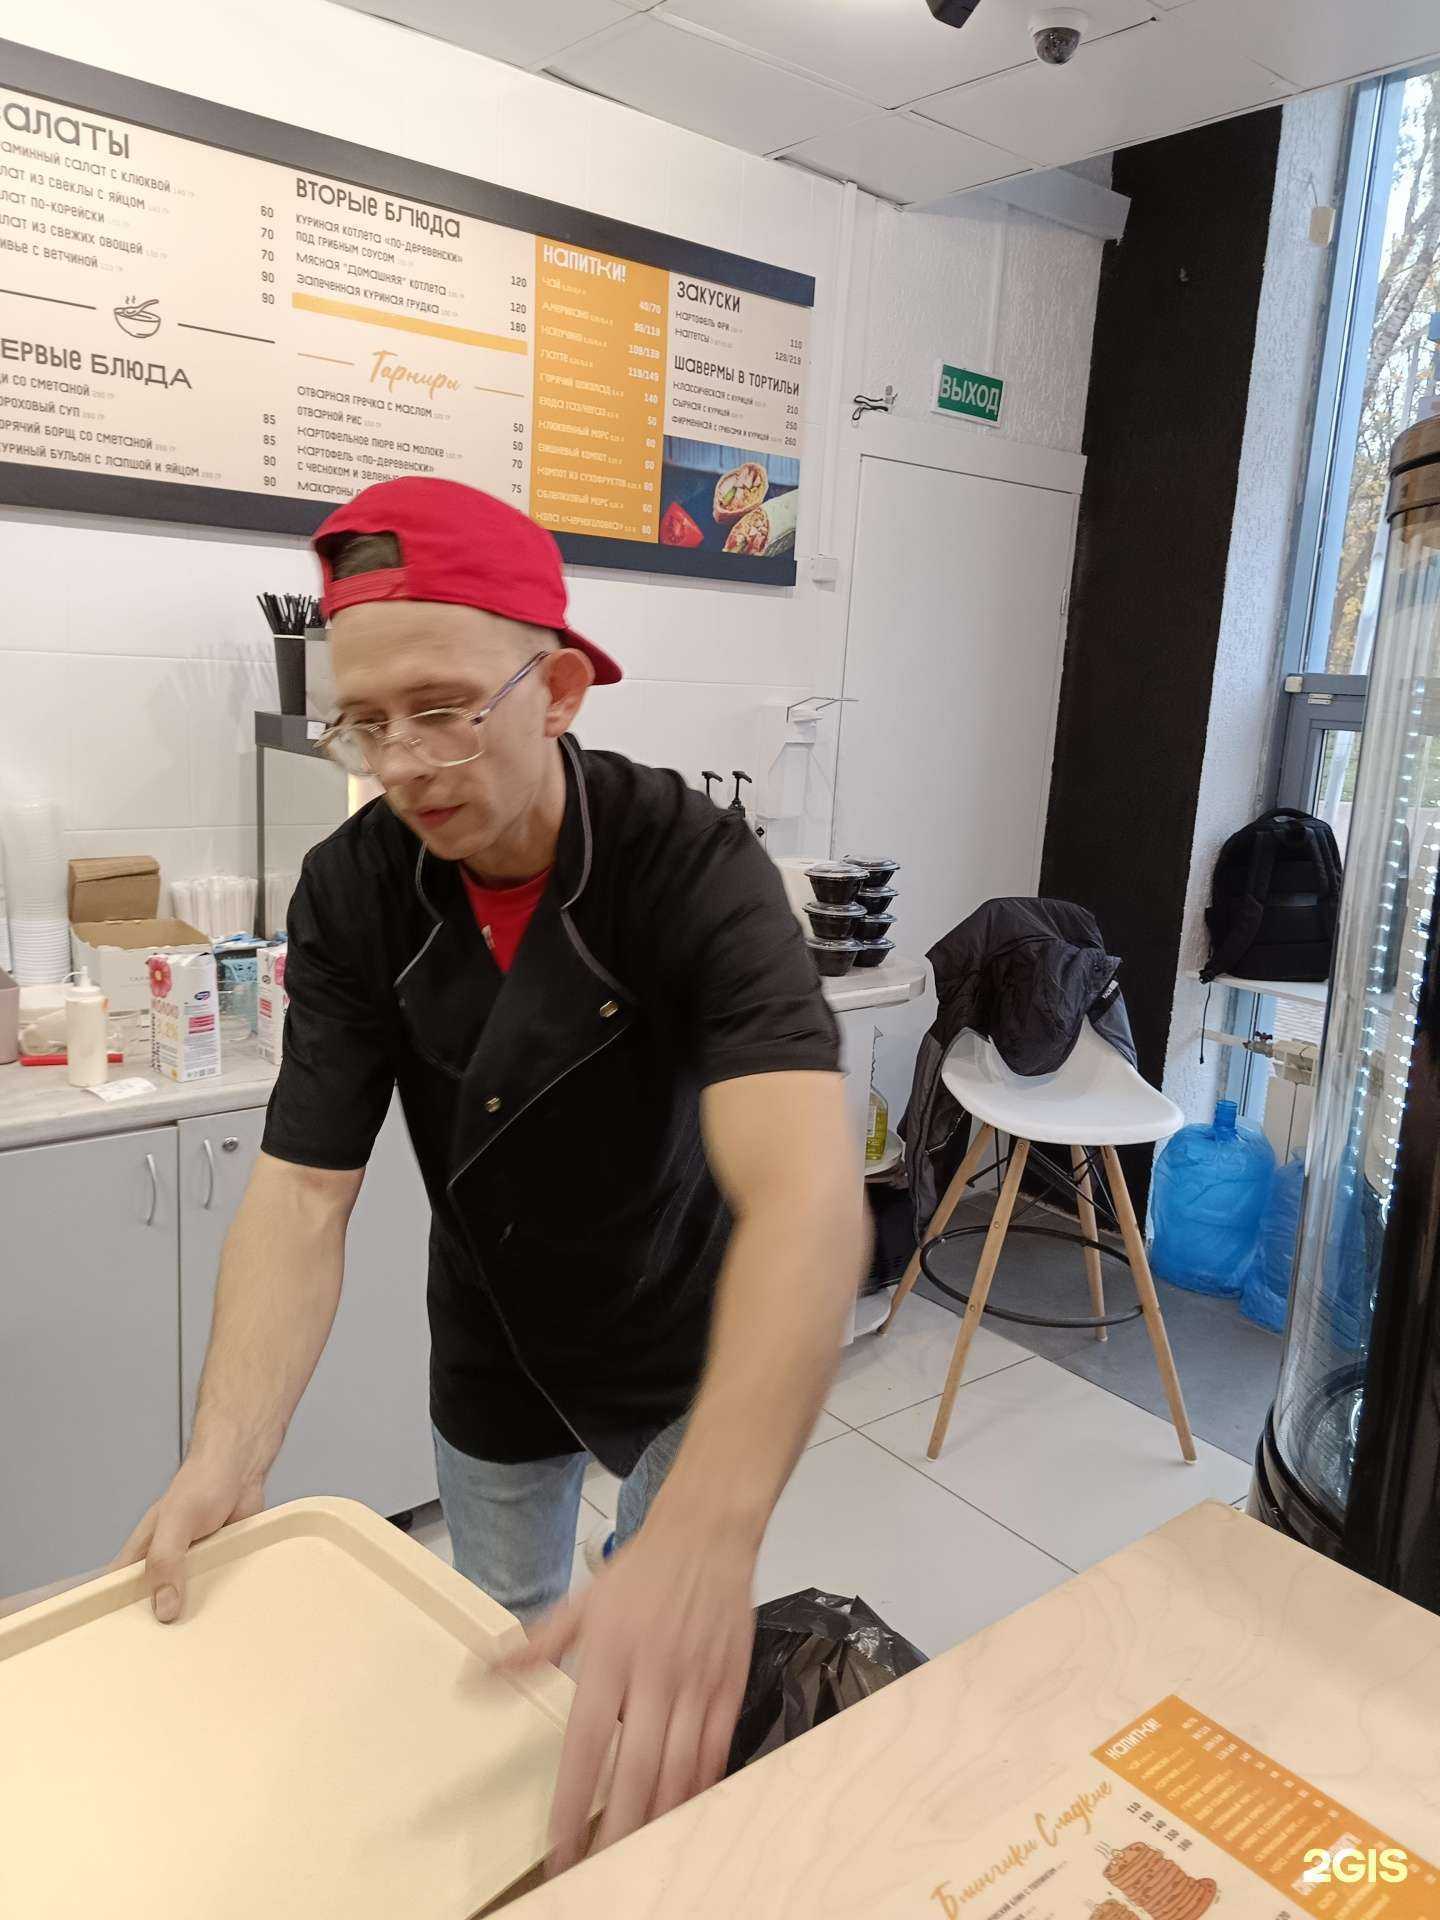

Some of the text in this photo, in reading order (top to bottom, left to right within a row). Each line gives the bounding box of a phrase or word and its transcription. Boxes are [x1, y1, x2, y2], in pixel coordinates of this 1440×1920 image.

[0, 102, 130, 159] АЛАТЫ
[260, 205, 274, 218] 60
[260, 227, 274, 240] 70
[261, 249, 275, 262] 70
[511, 275, 527, 288] 120
[510, 302, 527, 314] 120
[0, 337, 82, 371] ЕРВЫЕ
[940, 374, 1000, 416] ВЫХОД
[263, 413, 276, 425] 85
[513, 422, 524, 433] 50
[263, 434, 276, 446] 85
[512, 458, 523, 469] 70
[511, 483, 522, 494] 75
